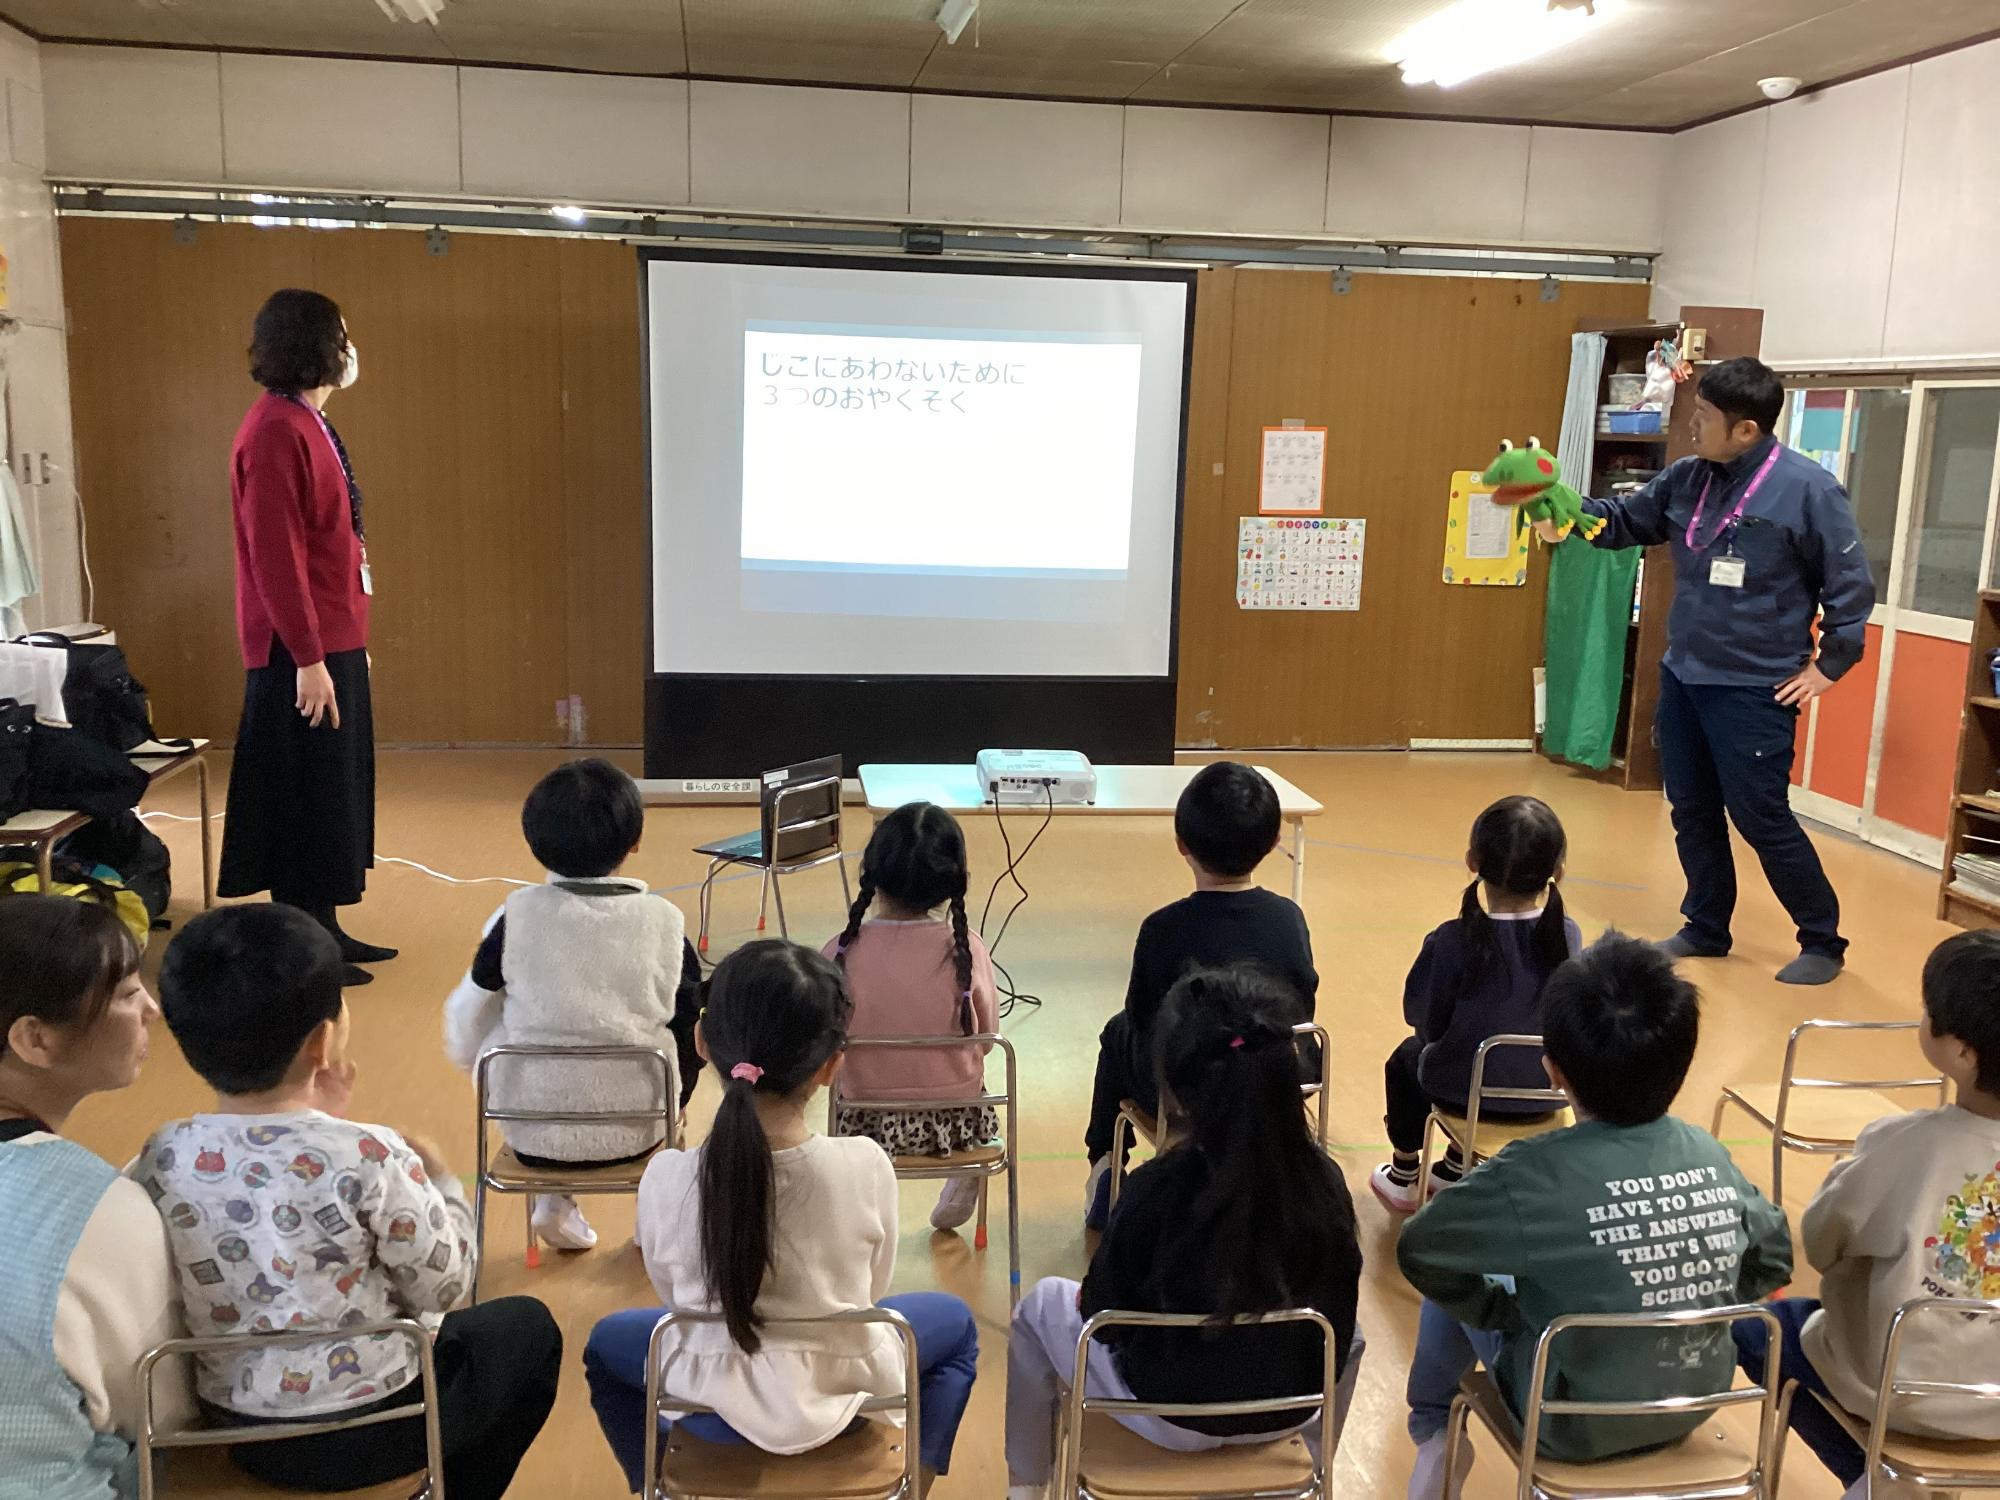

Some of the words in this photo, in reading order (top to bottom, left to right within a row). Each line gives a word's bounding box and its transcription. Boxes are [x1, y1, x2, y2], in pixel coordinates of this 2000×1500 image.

[762, 352, 1025, 385] じこにあわないために
[685, 782, 752, 791] 暮らしの安全課
[1605, 1177, 1655, 1196] YOU
[1658, 1166, 1718, 1190] DON'T
[1586, 1199, 1653, 1223] HAVE
[1656, 1194, 1687, 1212] TO
[1690, 1186, 1738, 1207] KNOW
[1589, 1223, 1643, 1246] THE
[1616, 1237, 1700, 1265] THAT'S
[1704, 1229, 1737, 1250] WHY
[1630, 1265, 1677, 1286] YOU
[1681, 1259, 1712, 1278] GO
[1714, 1253, 1738, 1271] TO
